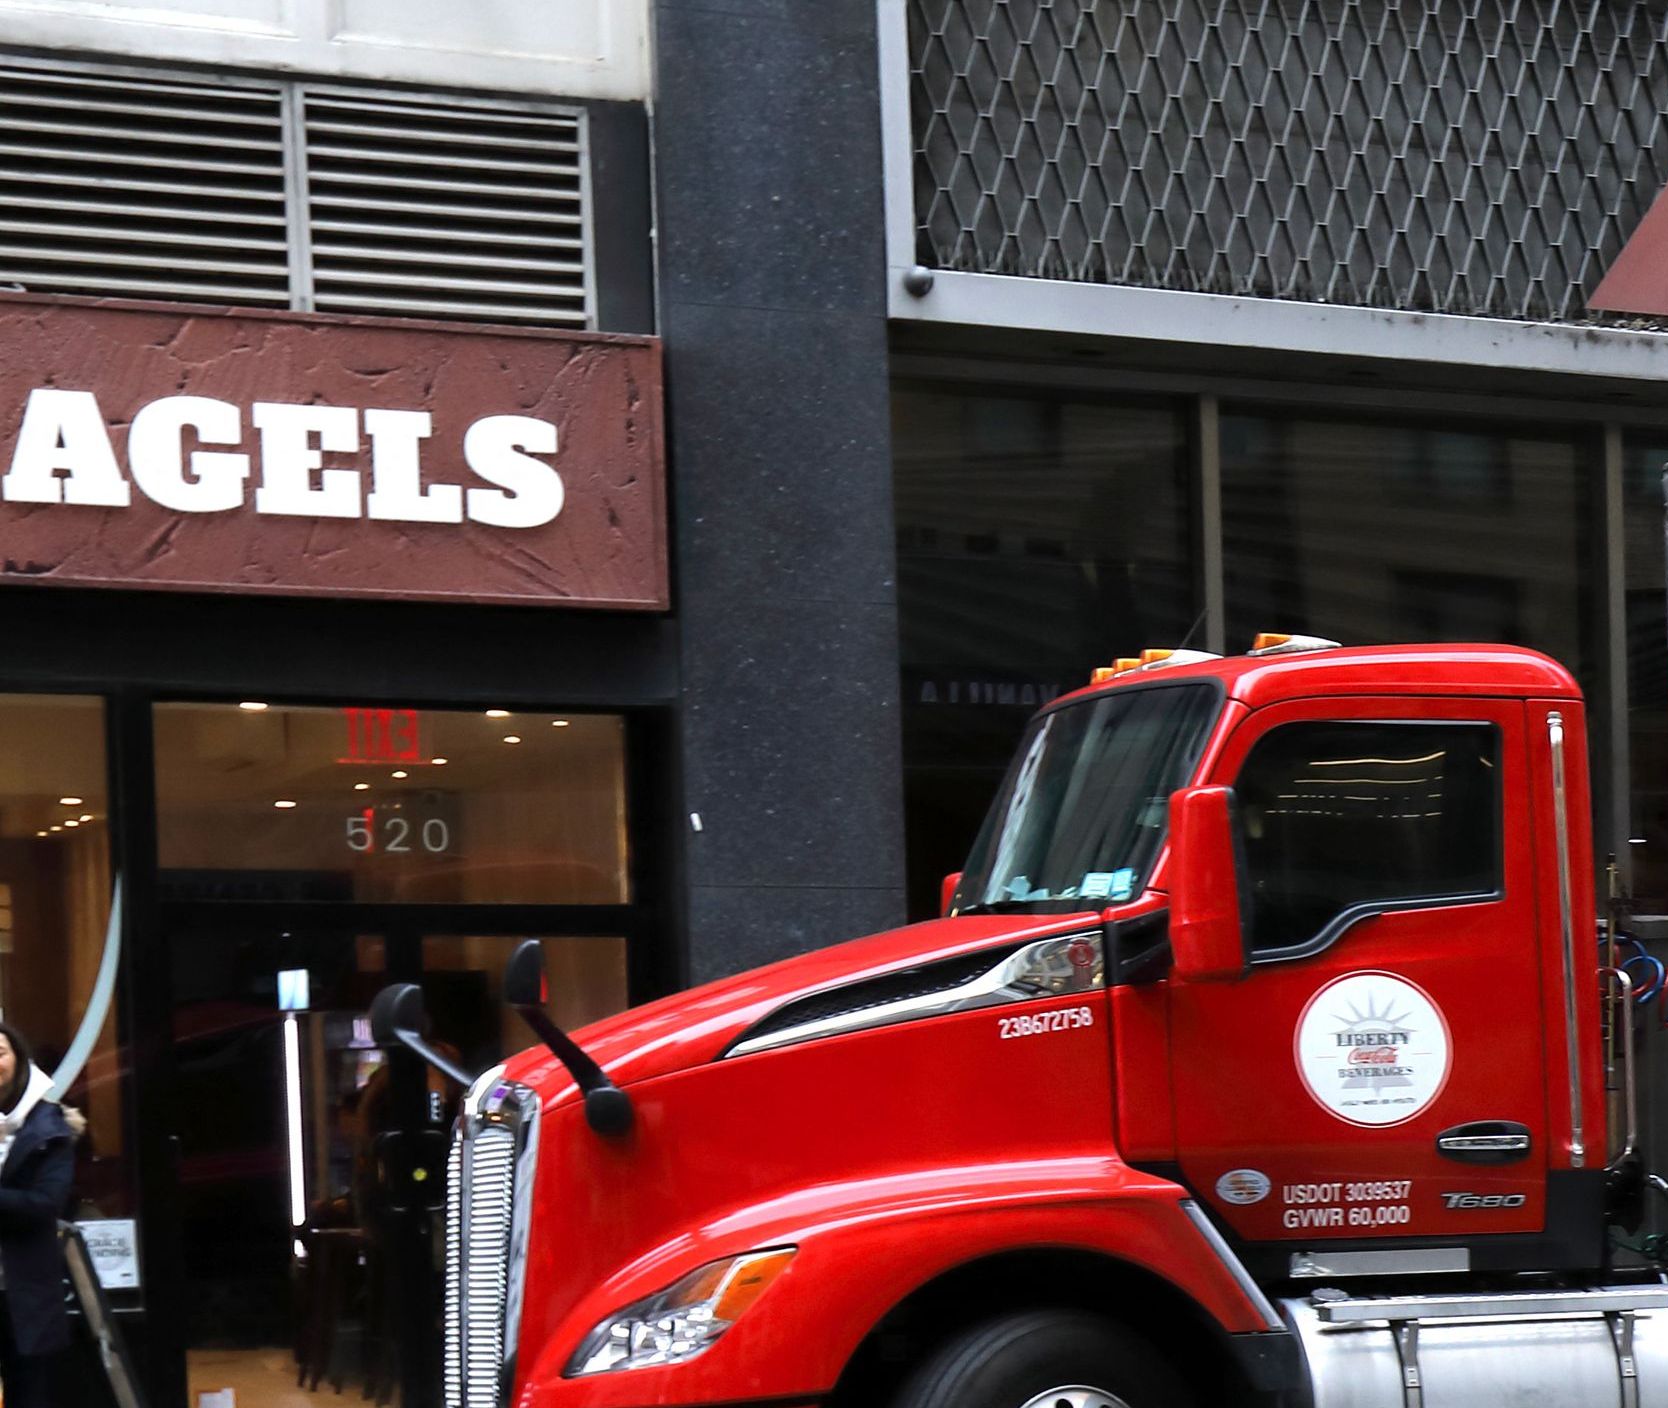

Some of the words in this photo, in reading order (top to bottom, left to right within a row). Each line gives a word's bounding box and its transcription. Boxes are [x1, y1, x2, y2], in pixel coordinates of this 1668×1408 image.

[346, 817, 449, 852] 520
[1336, 1032, 1409, 1047] LIBERTY
[1283, 1183, 1341, 1204] USDOT
[1345, 1180, 1411, 1201] 3039537
[1440, 1192, 1526, 1209] T680
[1283, 1207, 1344, 1228] GVWR
[1348, 1205, 1411, 1228] 60,000
